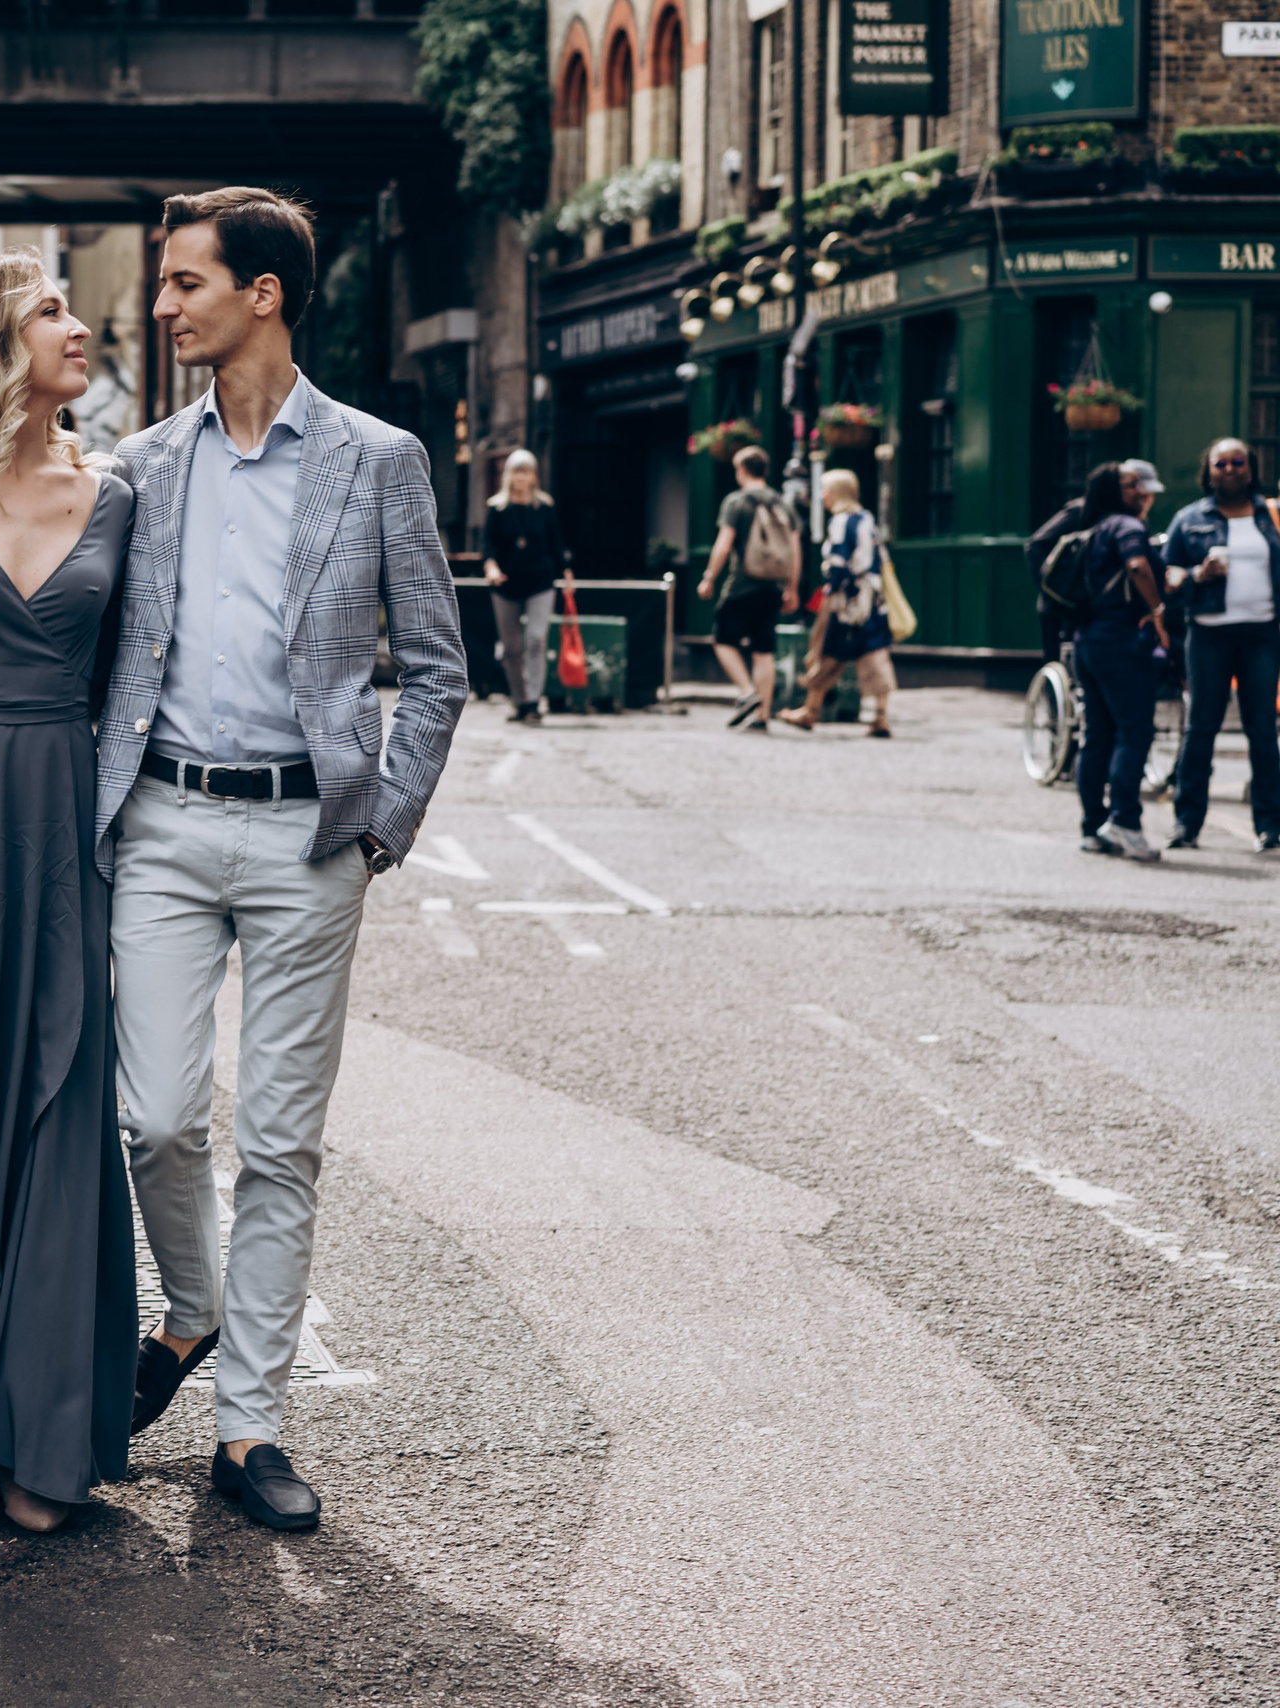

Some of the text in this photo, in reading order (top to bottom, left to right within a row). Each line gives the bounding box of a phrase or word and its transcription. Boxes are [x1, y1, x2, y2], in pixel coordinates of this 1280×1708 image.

[853, 2, 891, 20] THE
[853, 24, 927, 42] MARKET
[853, 45, 927, 64] PORTER
[1042, 34, 1089, 72] ALES
[1220, 243, 1275, 270] BAR
